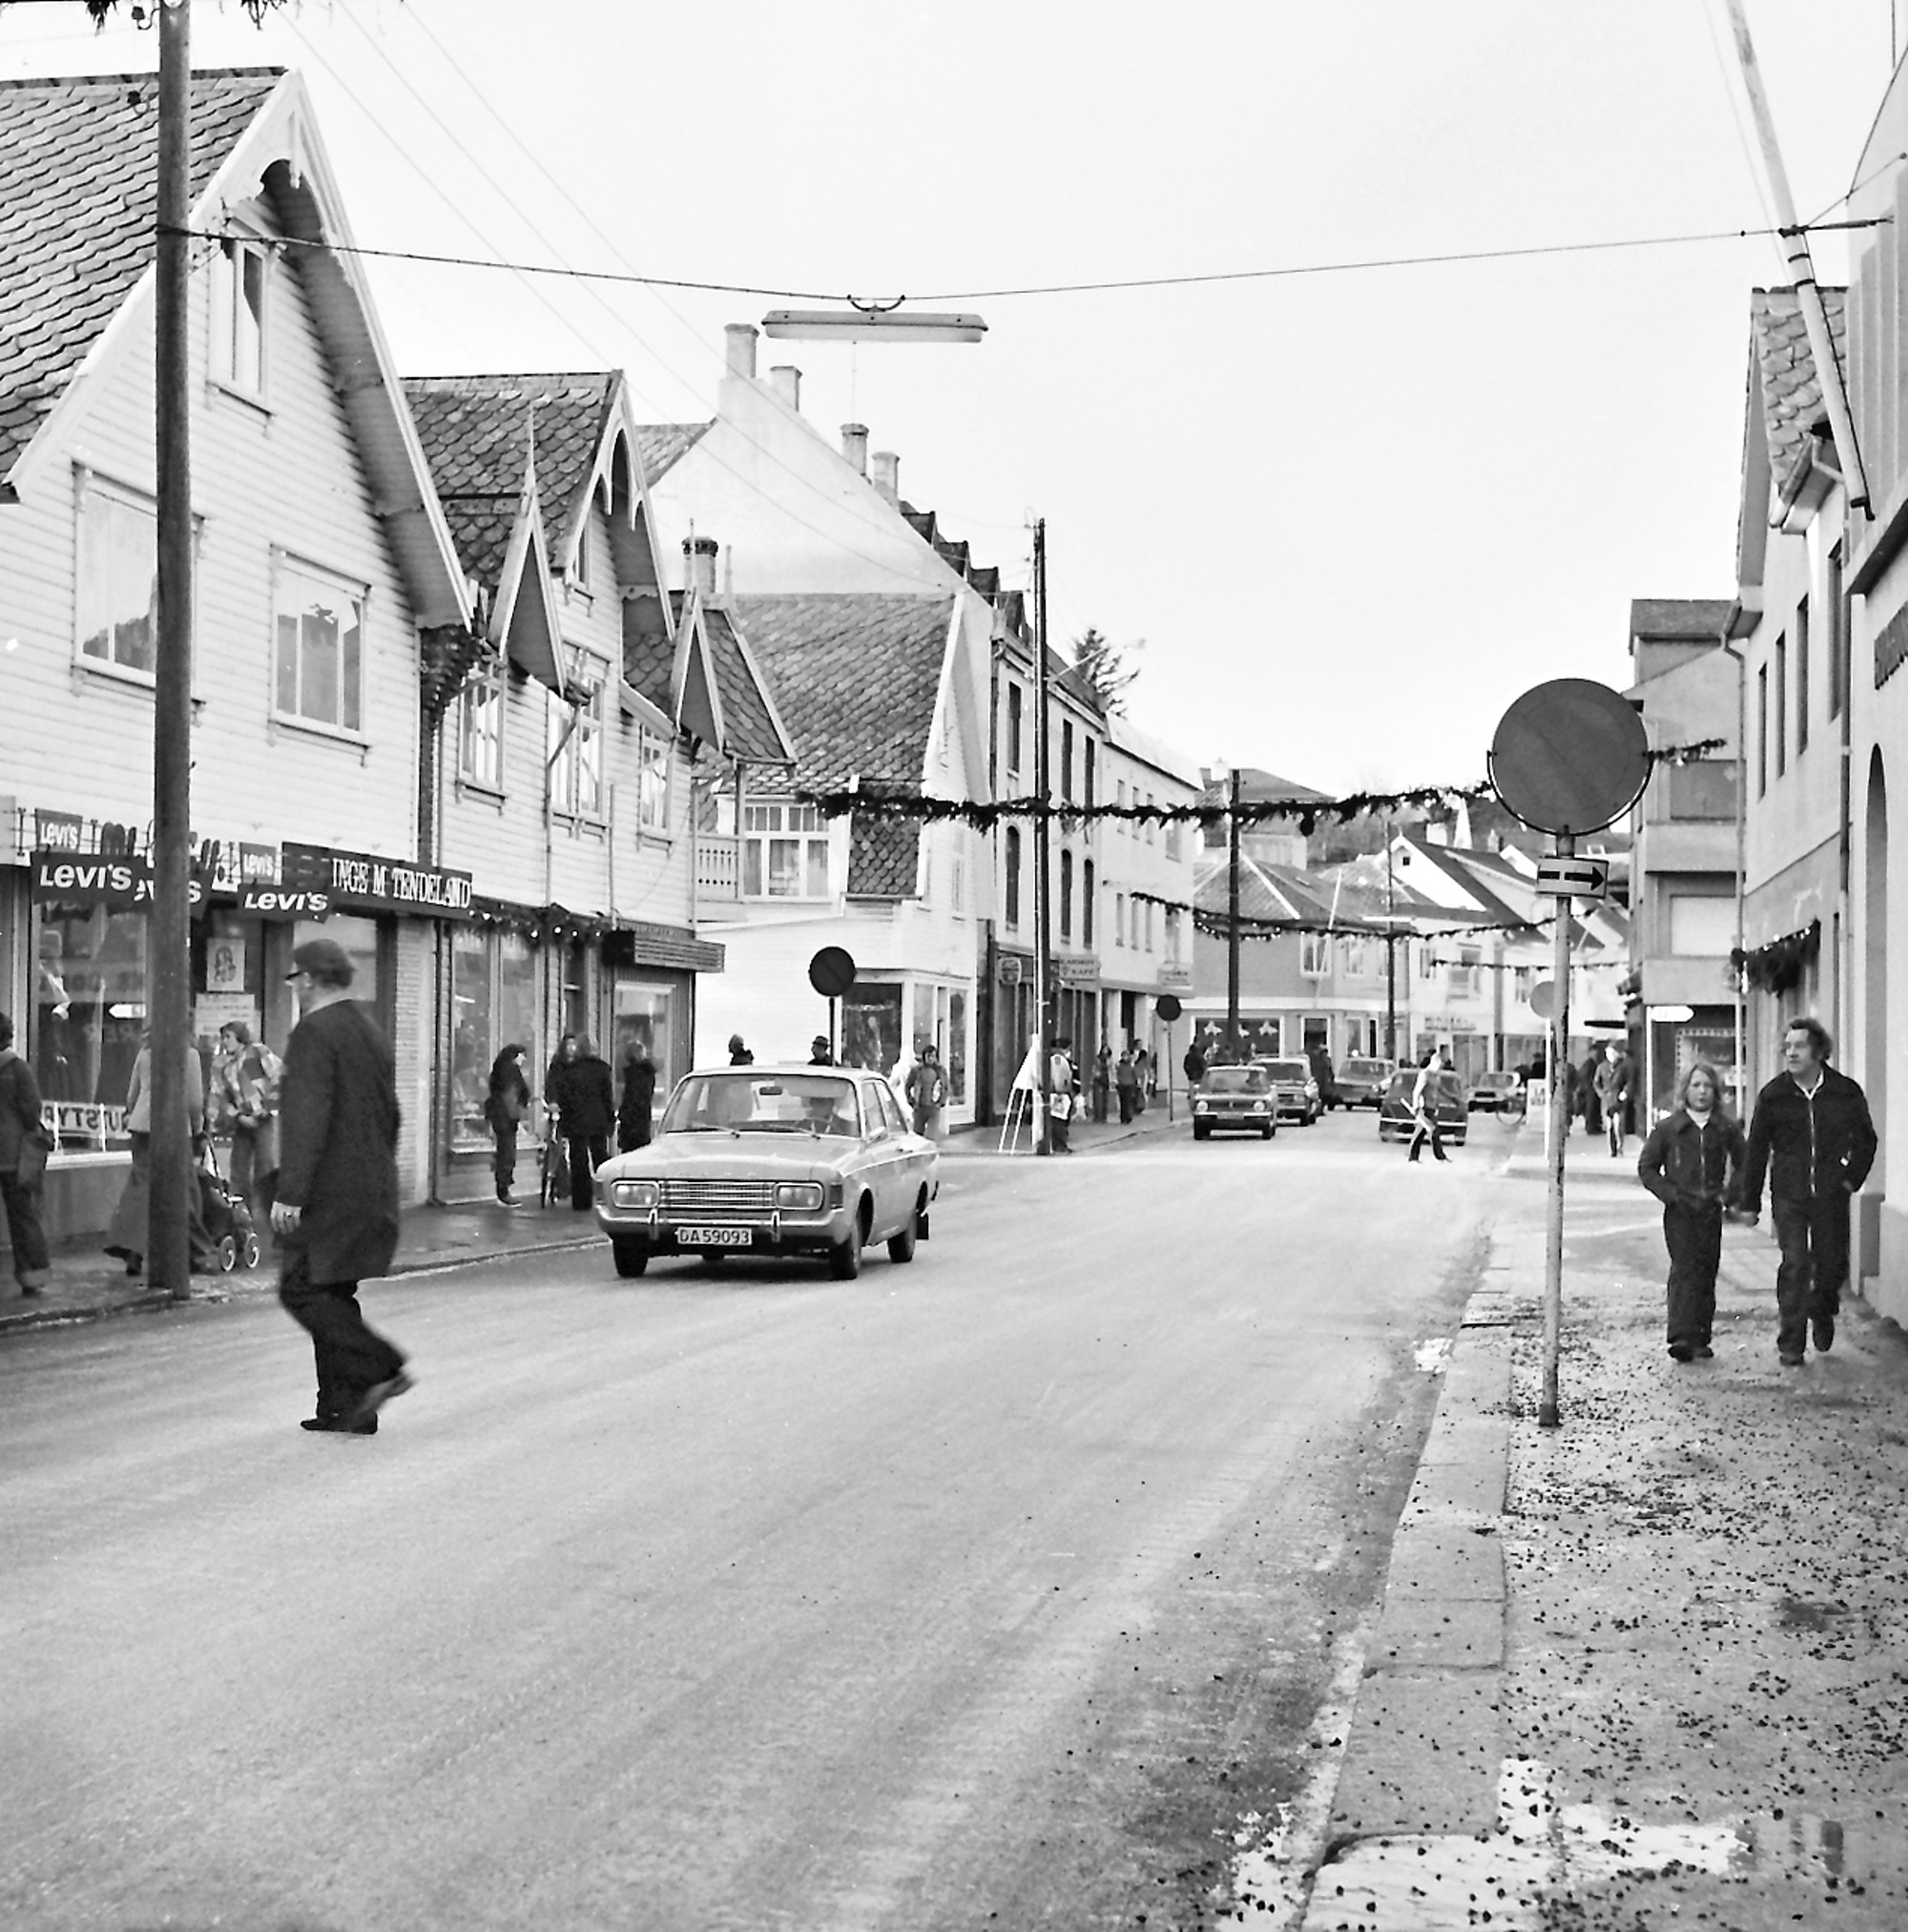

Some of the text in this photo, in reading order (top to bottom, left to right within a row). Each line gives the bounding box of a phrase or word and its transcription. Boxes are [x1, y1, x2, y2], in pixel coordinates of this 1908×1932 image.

[39, 862, 133, 891] Levi's
[391, 866, 471, 908] TENDELAND
[244, 892, 328, 911] Levi's
